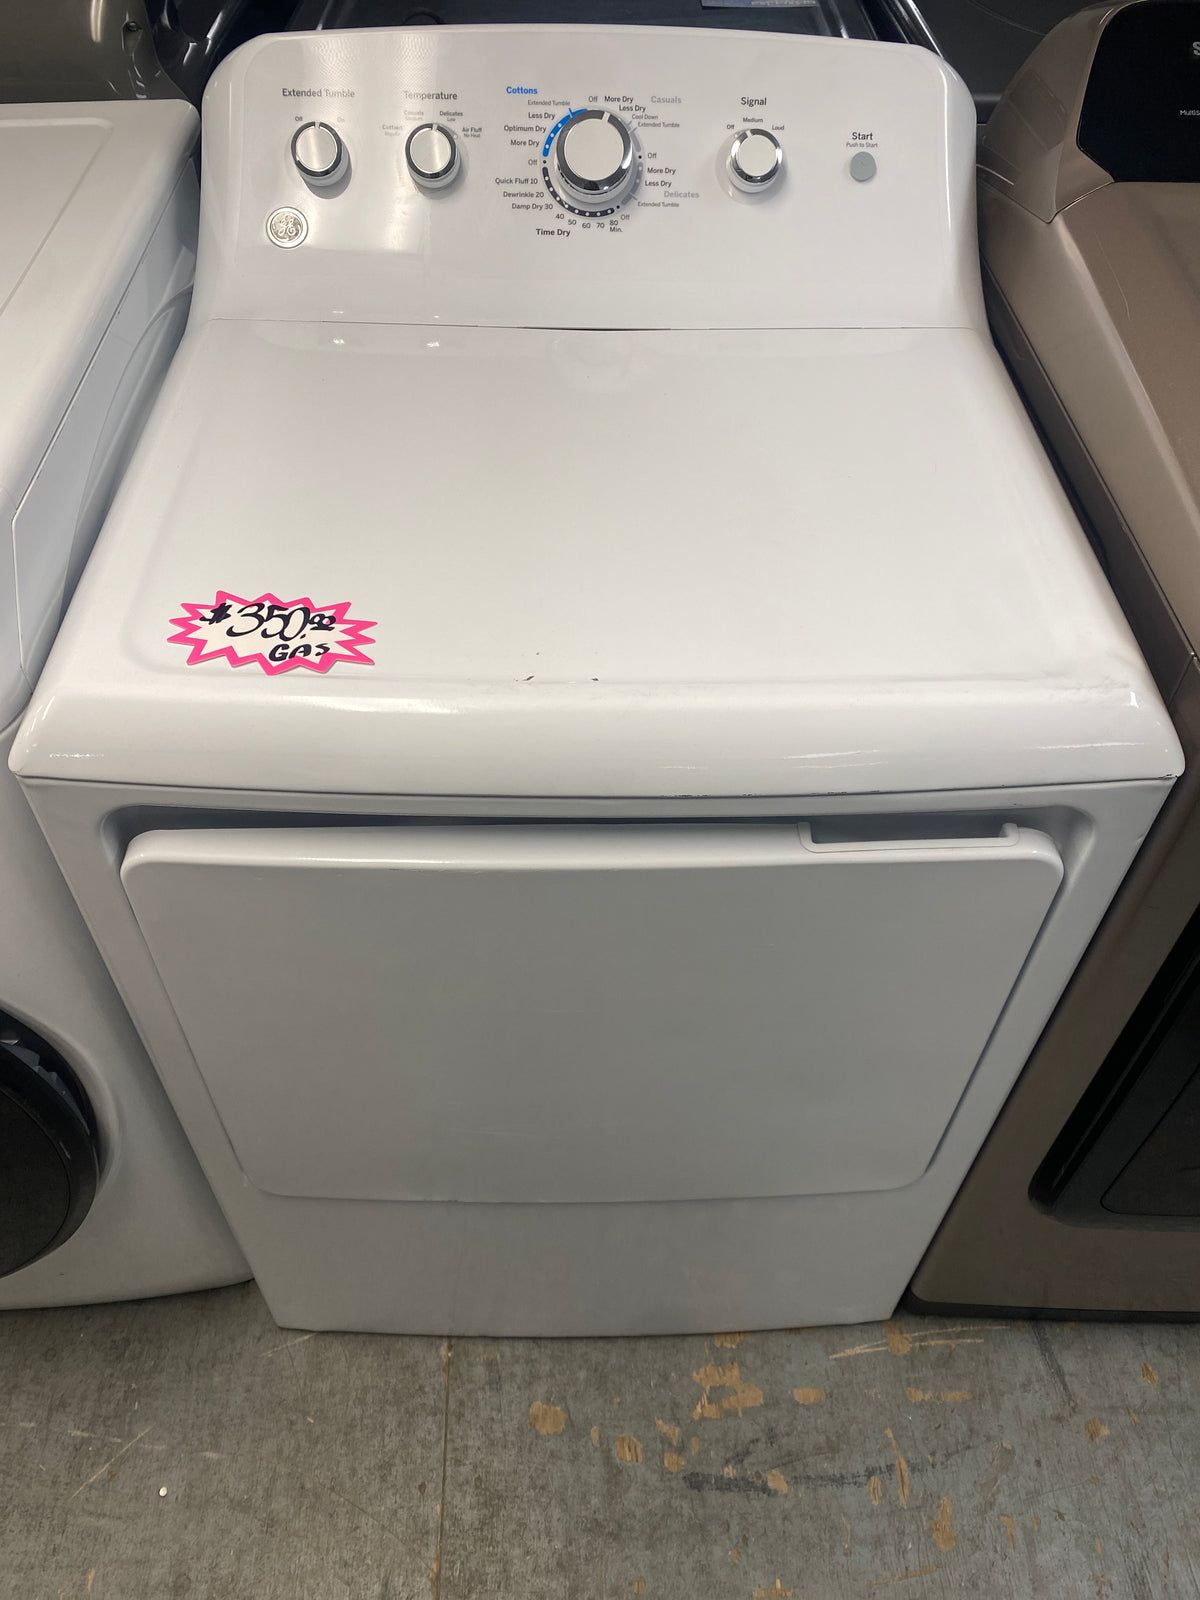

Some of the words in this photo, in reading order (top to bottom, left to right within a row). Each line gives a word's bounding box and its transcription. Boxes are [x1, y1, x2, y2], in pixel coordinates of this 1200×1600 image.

[282, 88, 322, 98] Extended
[324, 88, 356, 98] Tumble
[404, 90, 458, 100] Temperature
[506, 86, 538, 95] Cottons
[650, 96, 682, 104] Casuals
[740, 96, 767, 108] Signal
[544, 112, 556, 120] Dry
[504, 124, 534, 132] Optimum
[535, 125, 546, 133] Dry
[852, 131, 873, 141] Start
[528, 140, 540, 148] Dry
[664, 190, 700, 198] Delicates
[556, 229, 571, 238] Dry
[268, 643, 330, 662] GAS
